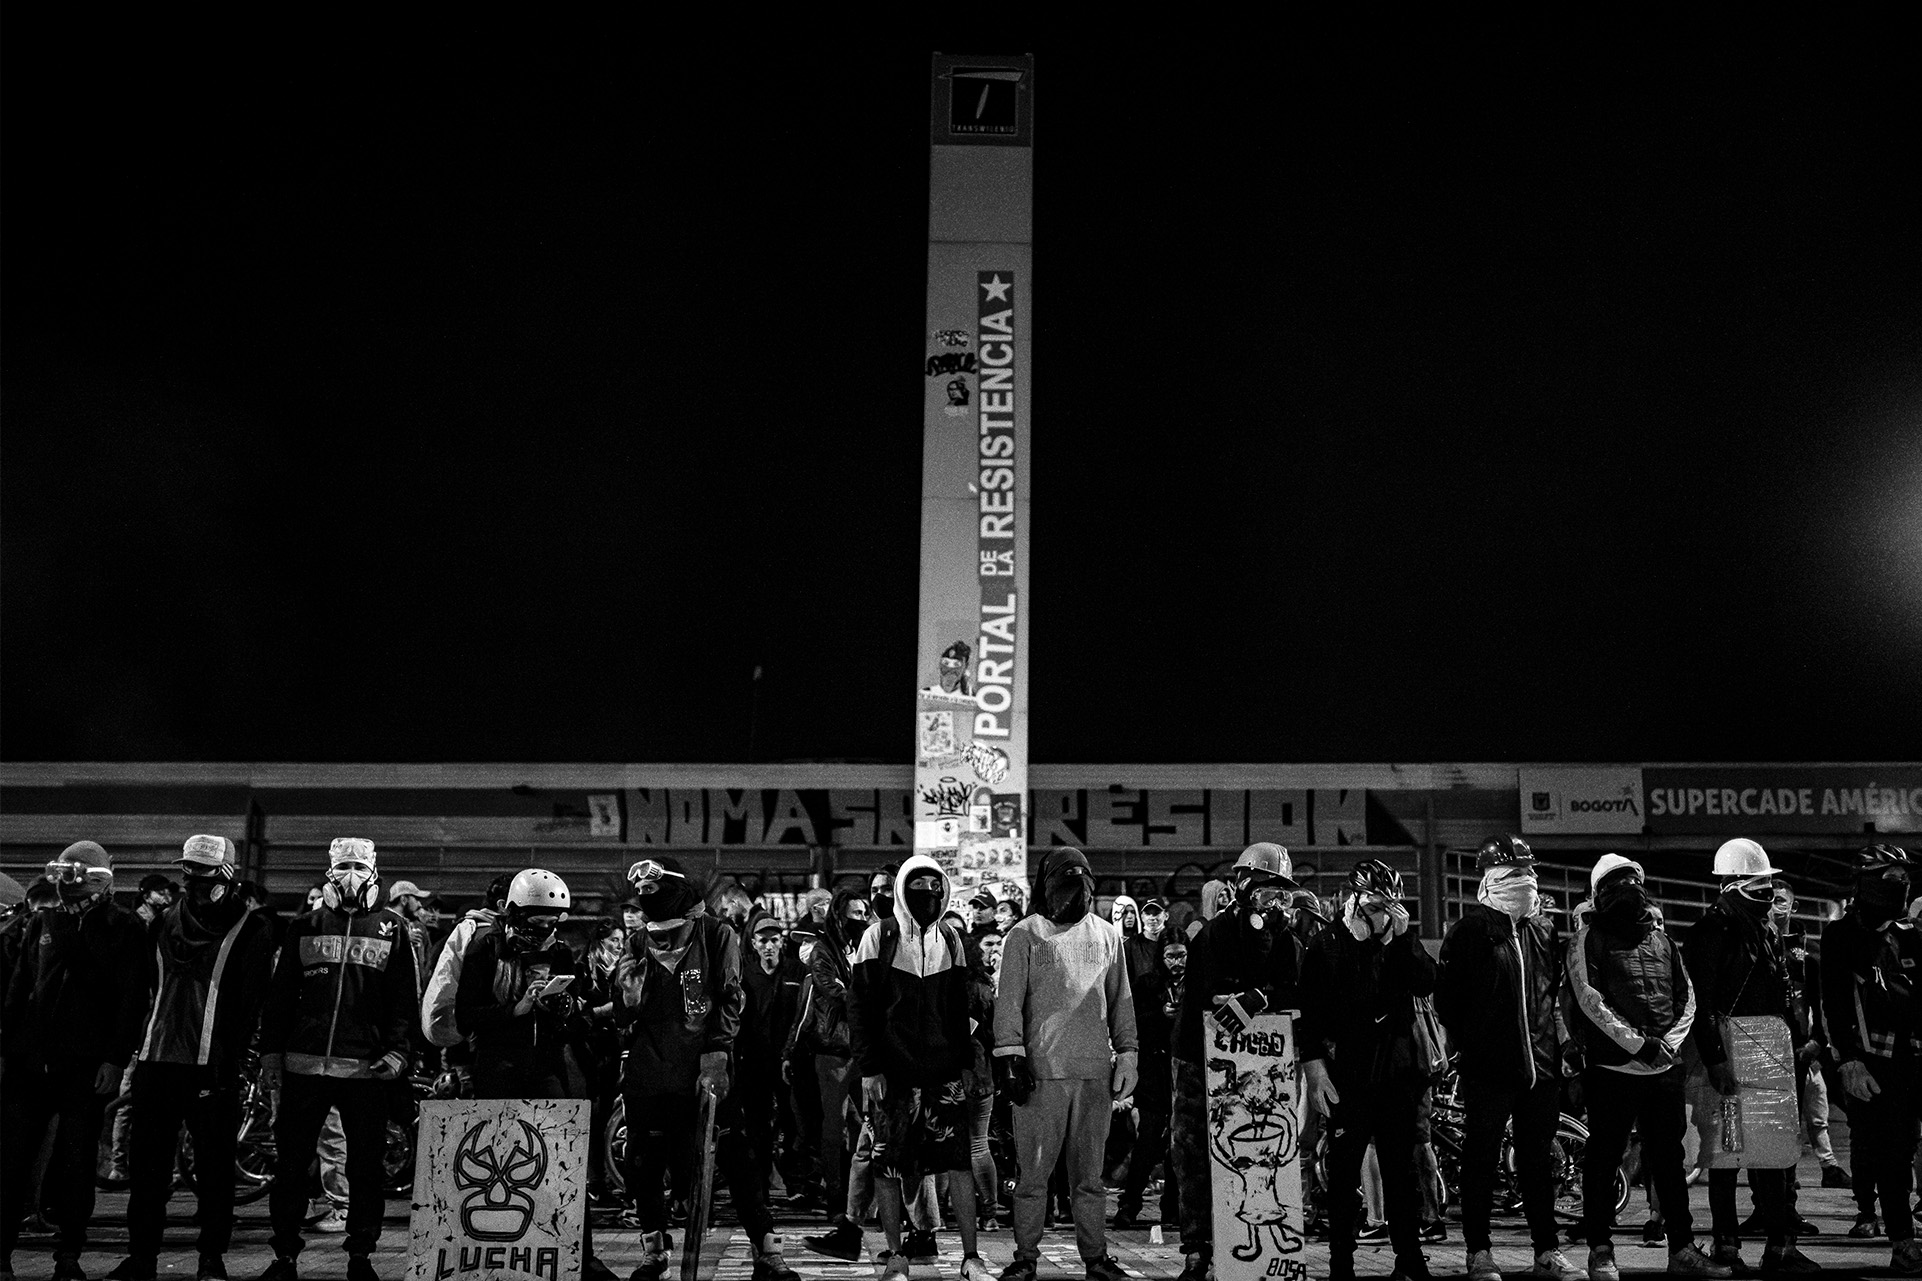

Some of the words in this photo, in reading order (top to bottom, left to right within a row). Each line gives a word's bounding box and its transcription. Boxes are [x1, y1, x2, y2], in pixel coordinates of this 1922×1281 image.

[980, 550, 997, 577] DE
[998, 550, 1014, 577] LA
[974, 593, 1016, 737] PORTAL
[1651, 787, 1814, 816] SUPERCADE
[435, 1246, 559, 1281] LUCHA
